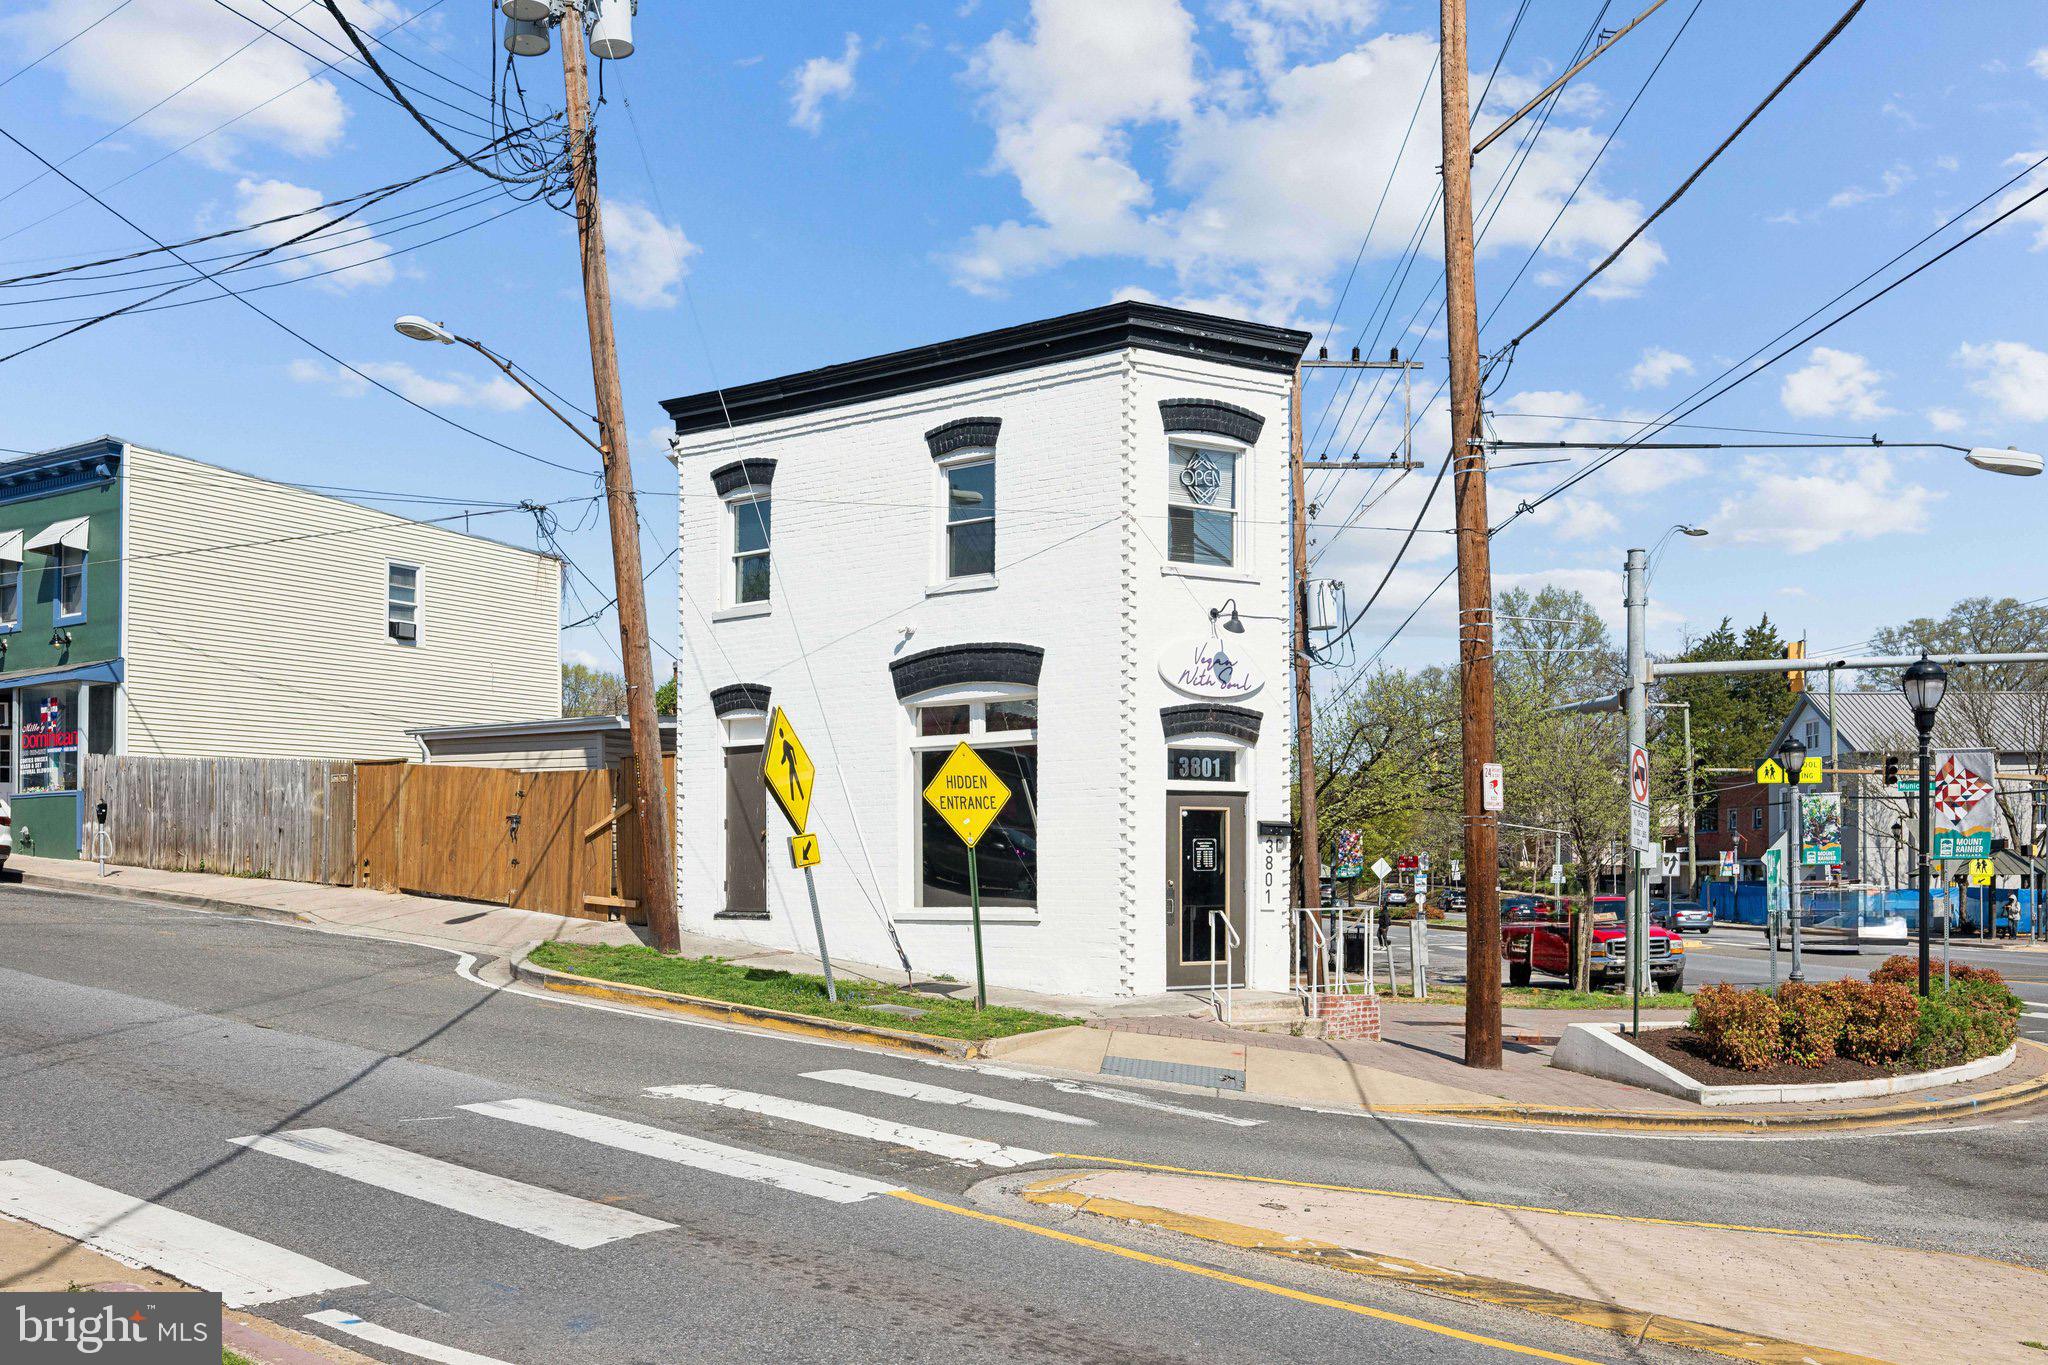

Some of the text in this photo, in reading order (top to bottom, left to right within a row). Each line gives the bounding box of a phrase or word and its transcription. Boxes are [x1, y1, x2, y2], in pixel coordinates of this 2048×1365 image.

[1180, 469, 1221, 487] OPEN
[1194, 642, 1238, 671] Vegan
[1178, 666, 1252, 691] With Soul
[22, 730, 78, 749] Dominican
[1179, 756, 1220, 778] 3801
[946, 775, 988, 789] HIDDEN
[1900, 782, 1933, 790] Municl
[940, 795, 997, 810] ENTRANCE
[1955, 845, 1984, 853] RAINIER
[1956, 838, 1983, 846] MOUNT
[1265, 839, 1274, 905] 3801
